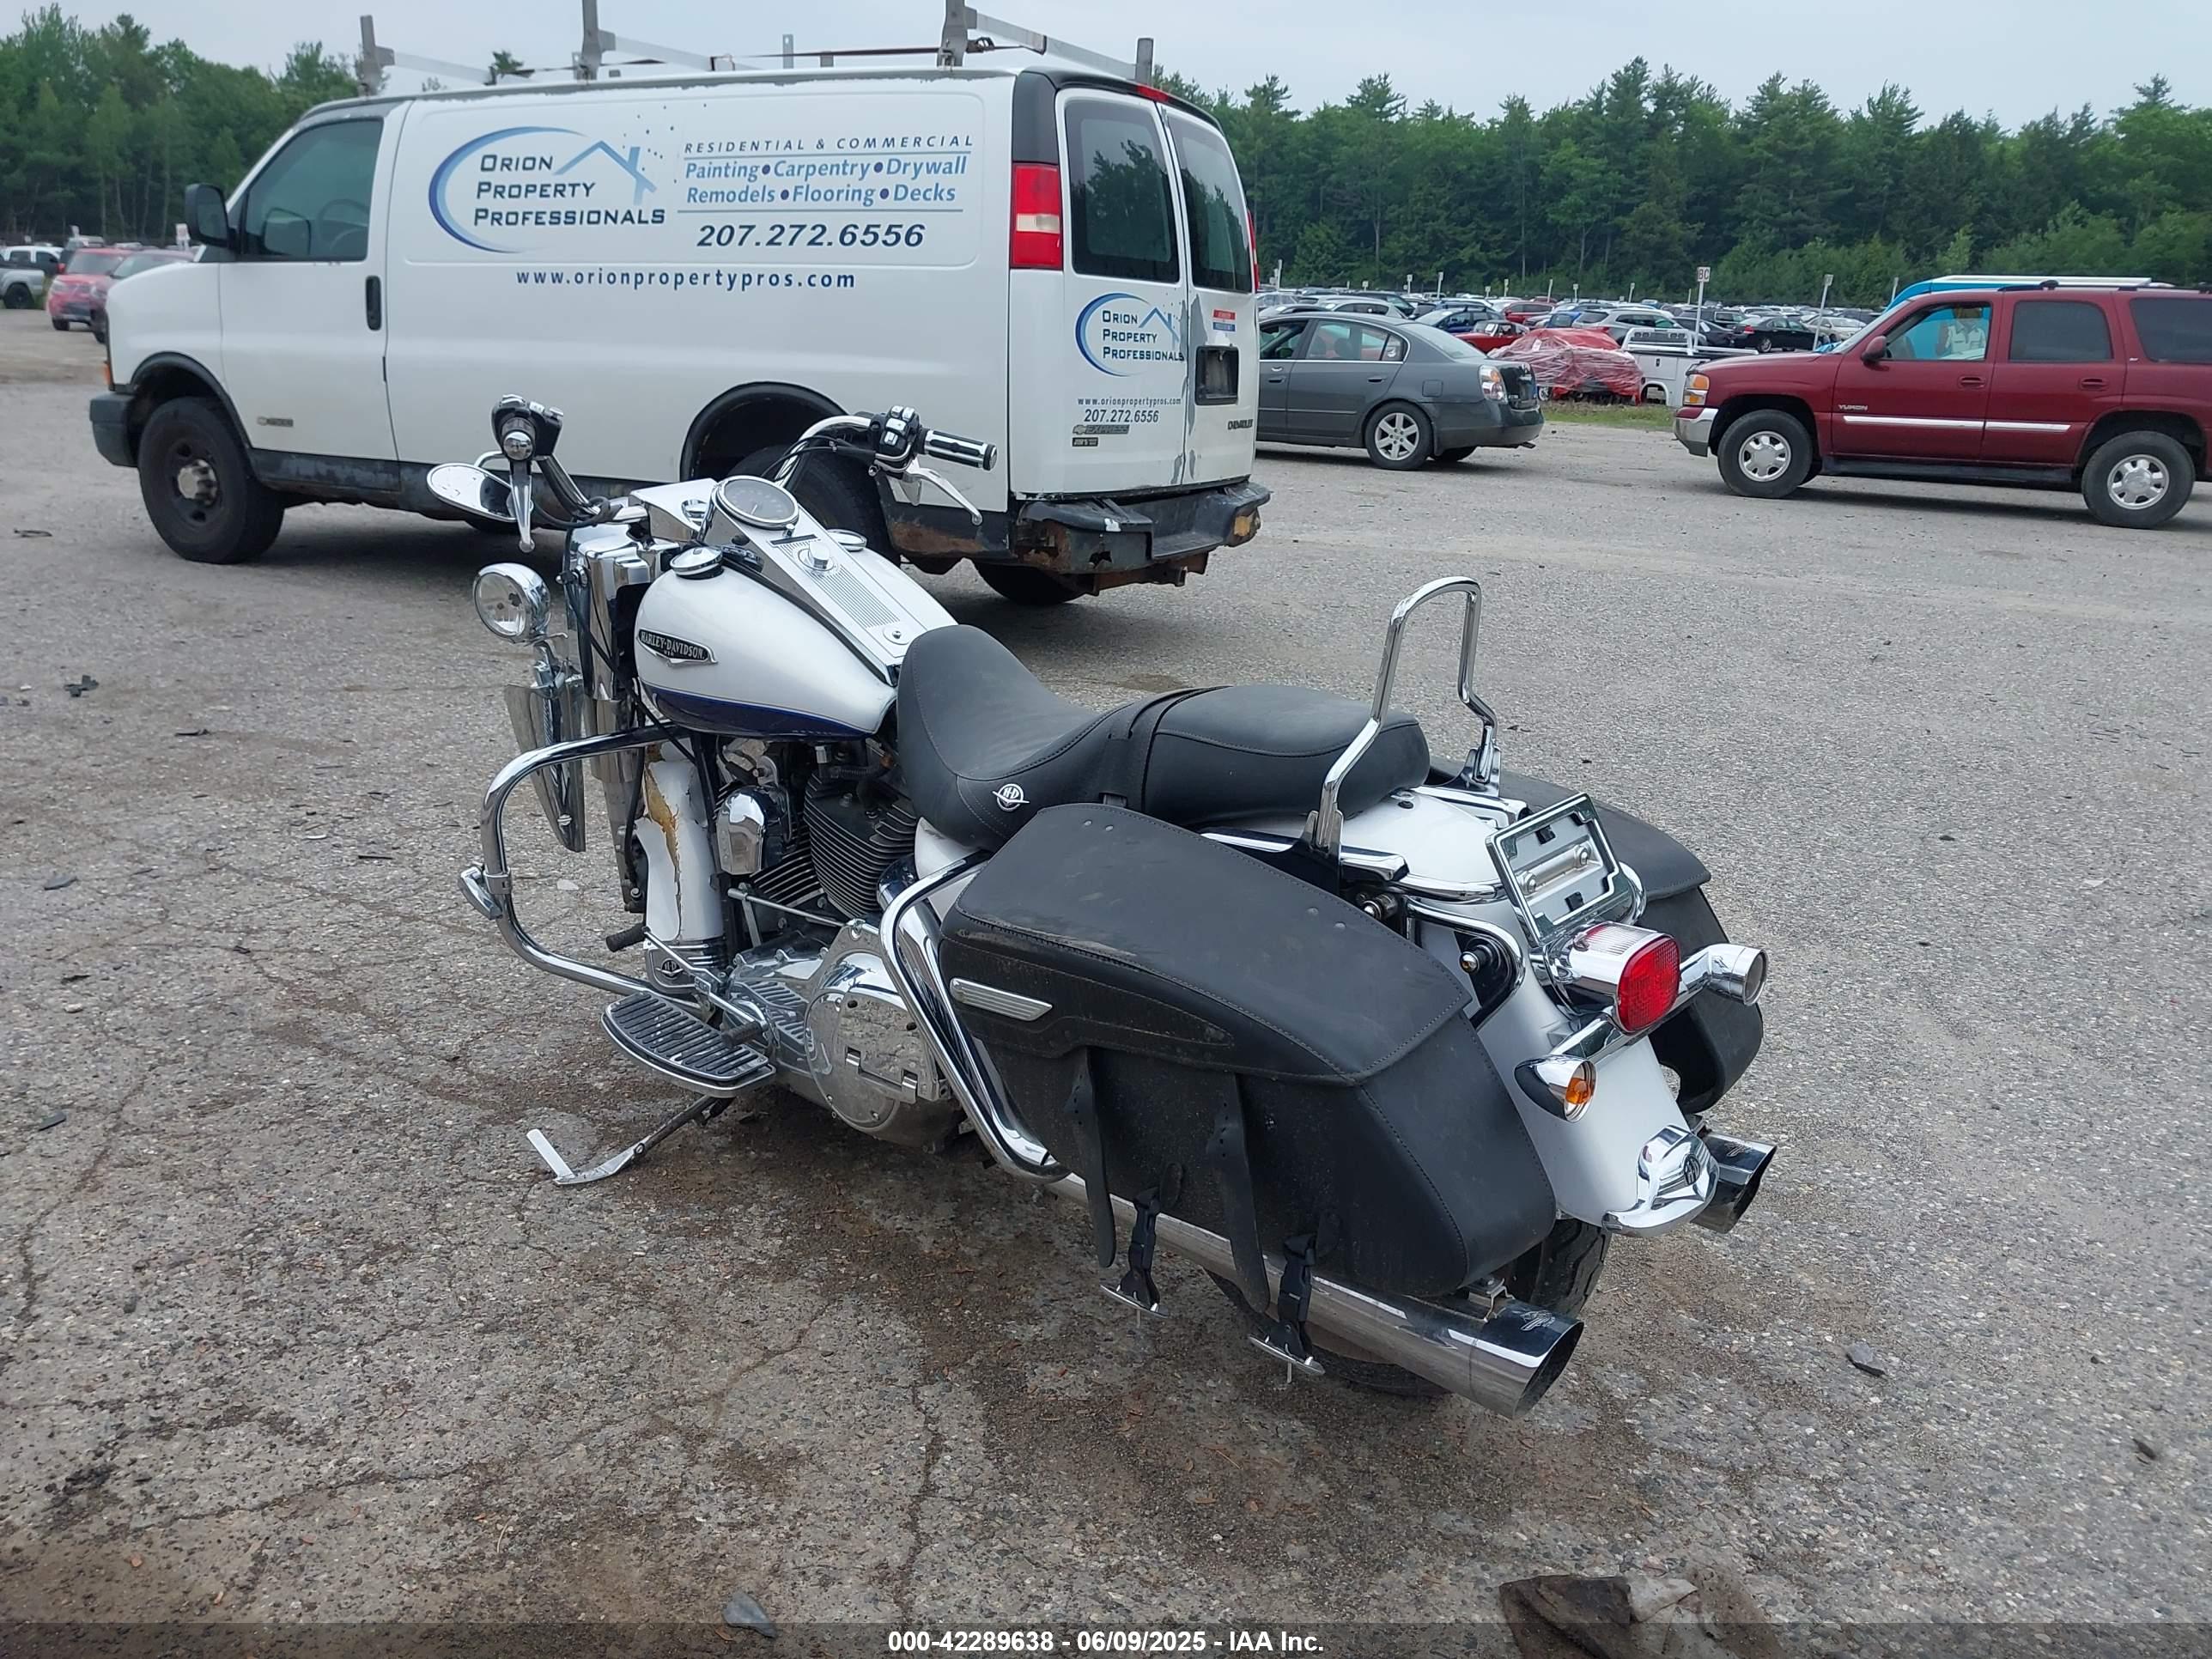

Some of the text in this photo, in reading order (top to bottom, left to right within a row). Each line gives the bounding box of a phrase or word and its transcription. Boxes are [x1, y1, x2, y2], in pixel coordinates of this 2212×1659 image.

[684, 136, 973, 154] RESIDENTIAL & COMMERCIAL
[687, 182, 956, 207] Remodels Flooring Decks
[697, 224, 926, 247] 207.272.6556
[516, 267, 855, 289] www.orionpropertypros.com
[1078, 396, 1182, 407] www.orionpropertypros.com
[1084, 409, 1159, 423] 207.272.6556
